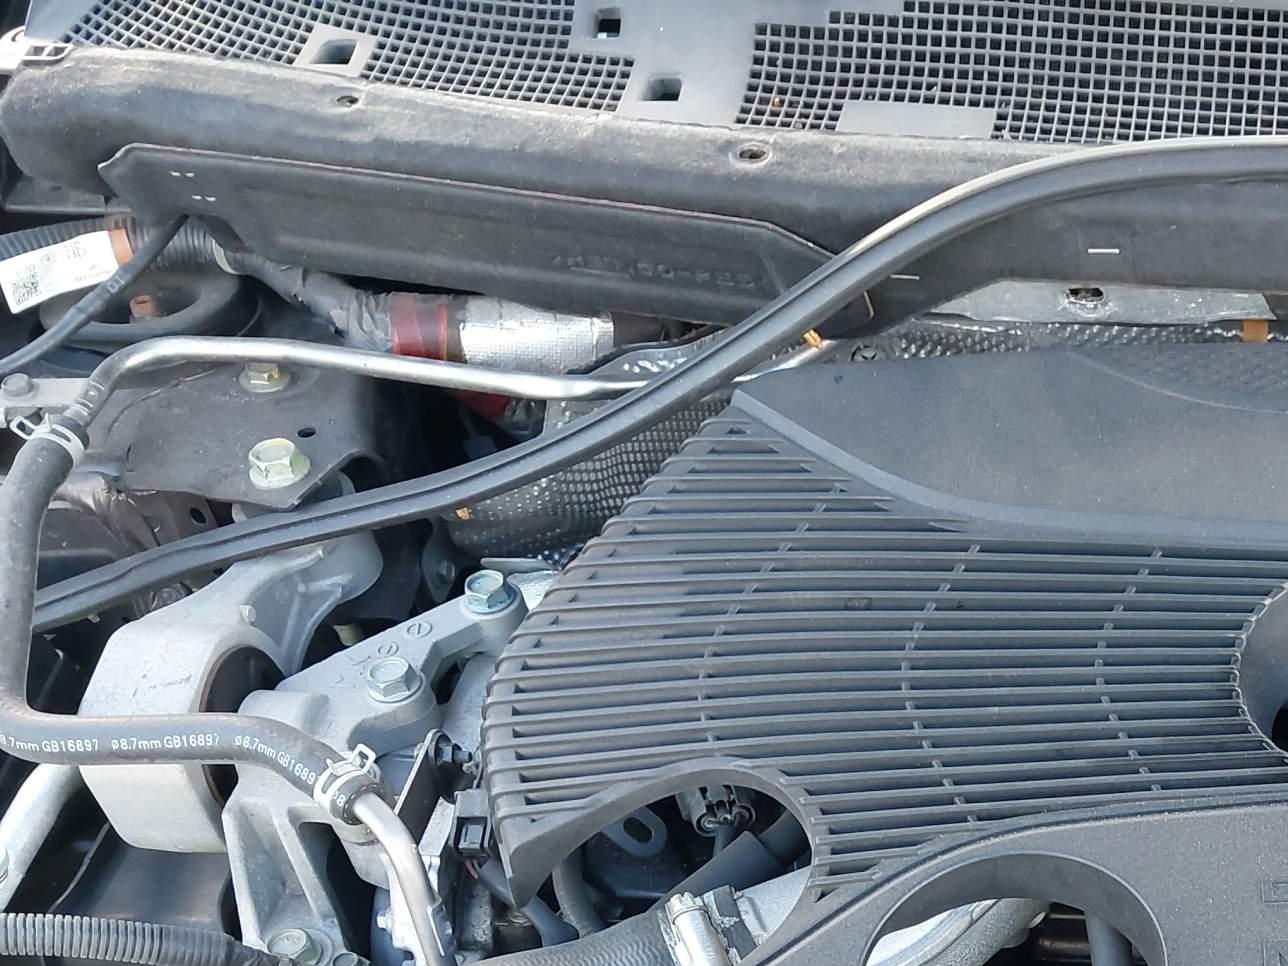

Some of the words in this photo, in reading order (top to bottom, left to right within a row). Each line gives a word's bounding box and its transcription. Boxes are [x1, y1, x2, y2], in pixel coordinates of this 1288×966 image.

[42, 738, 100, 752] GB16897
[163, 732, 220, 750] GB16897
[277, 752, 322, 786] GB1689
